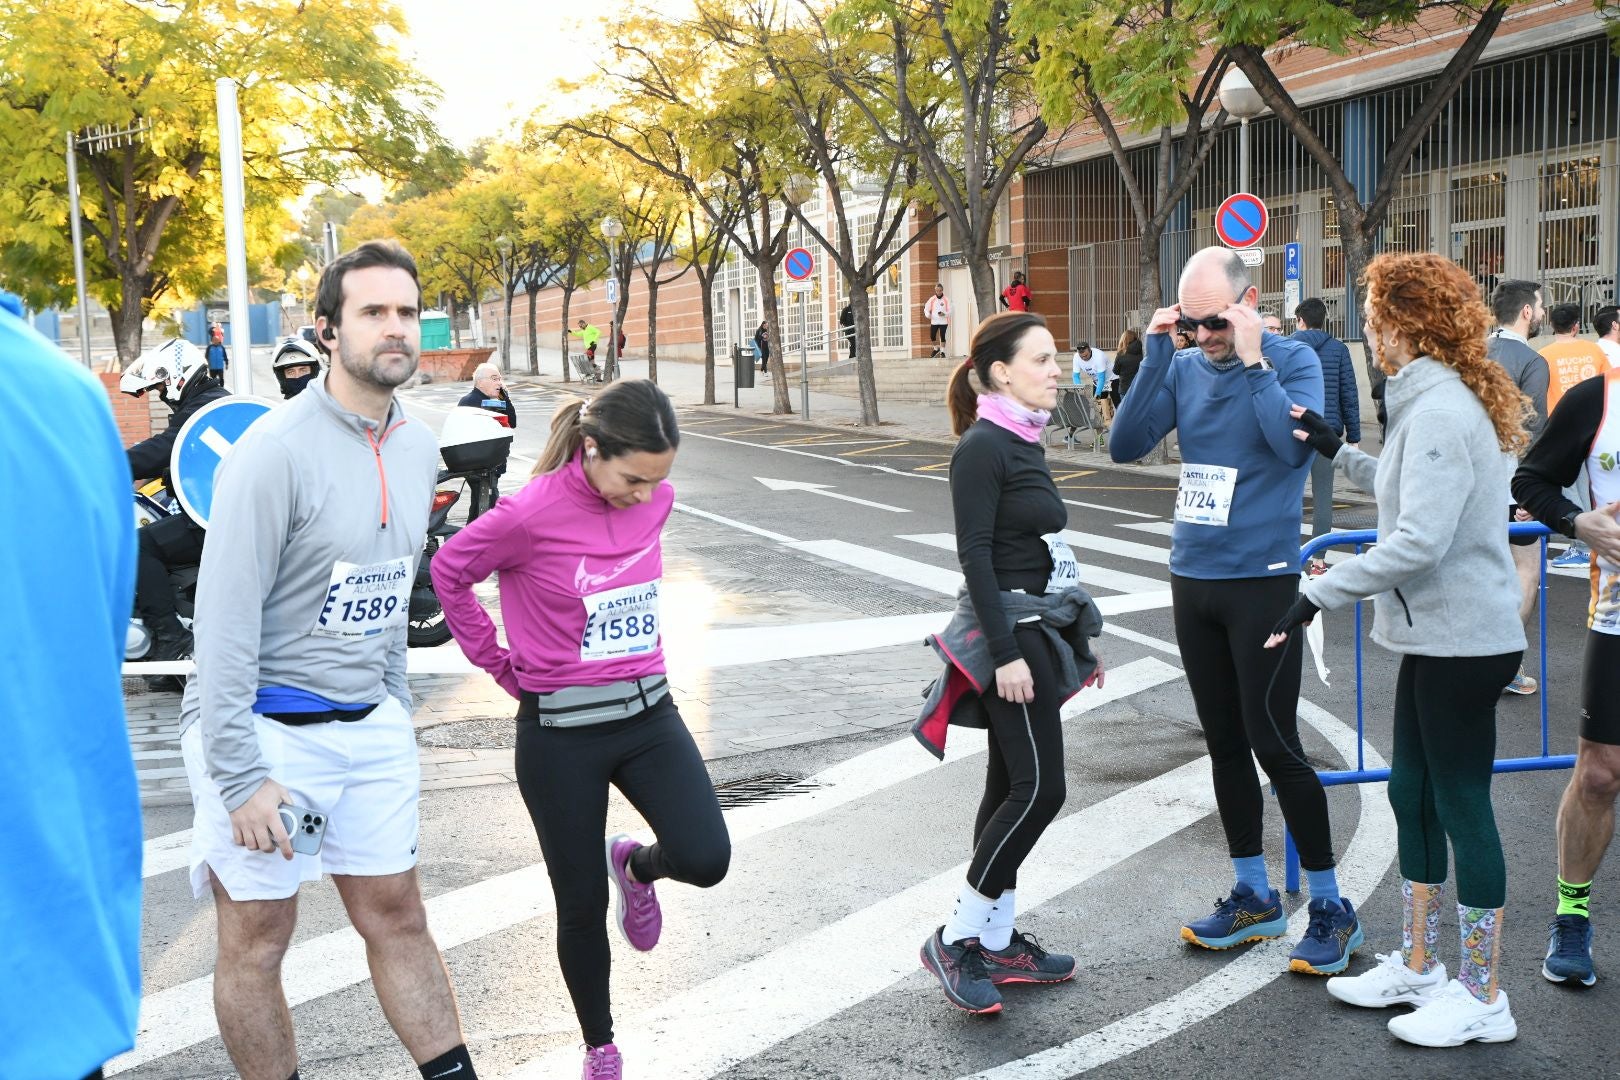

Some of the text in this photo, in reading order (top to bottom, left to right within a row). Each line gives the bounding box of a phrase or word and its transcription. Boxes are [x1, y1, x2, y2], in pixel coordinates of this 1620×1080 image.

[1288, 248, 1296, 262] P
[1556, 356, 1593, 366] MUCHO
[1559, 374, 1579, 384] QUE
[1183, 471, 1227, 481] CASTILLOS
[1183, 490, 1216, 510] 1724
[345, 569, 406, 585] CASTILLOS
[352, 581, 397, 595] ALICANTE
[341, 595, 398, 622] 1589
[598, 590, 658, 611] CASTILLOS
[607, 601, 652, 617] ALICANTE
[598, 613, 655, 641] 1588
